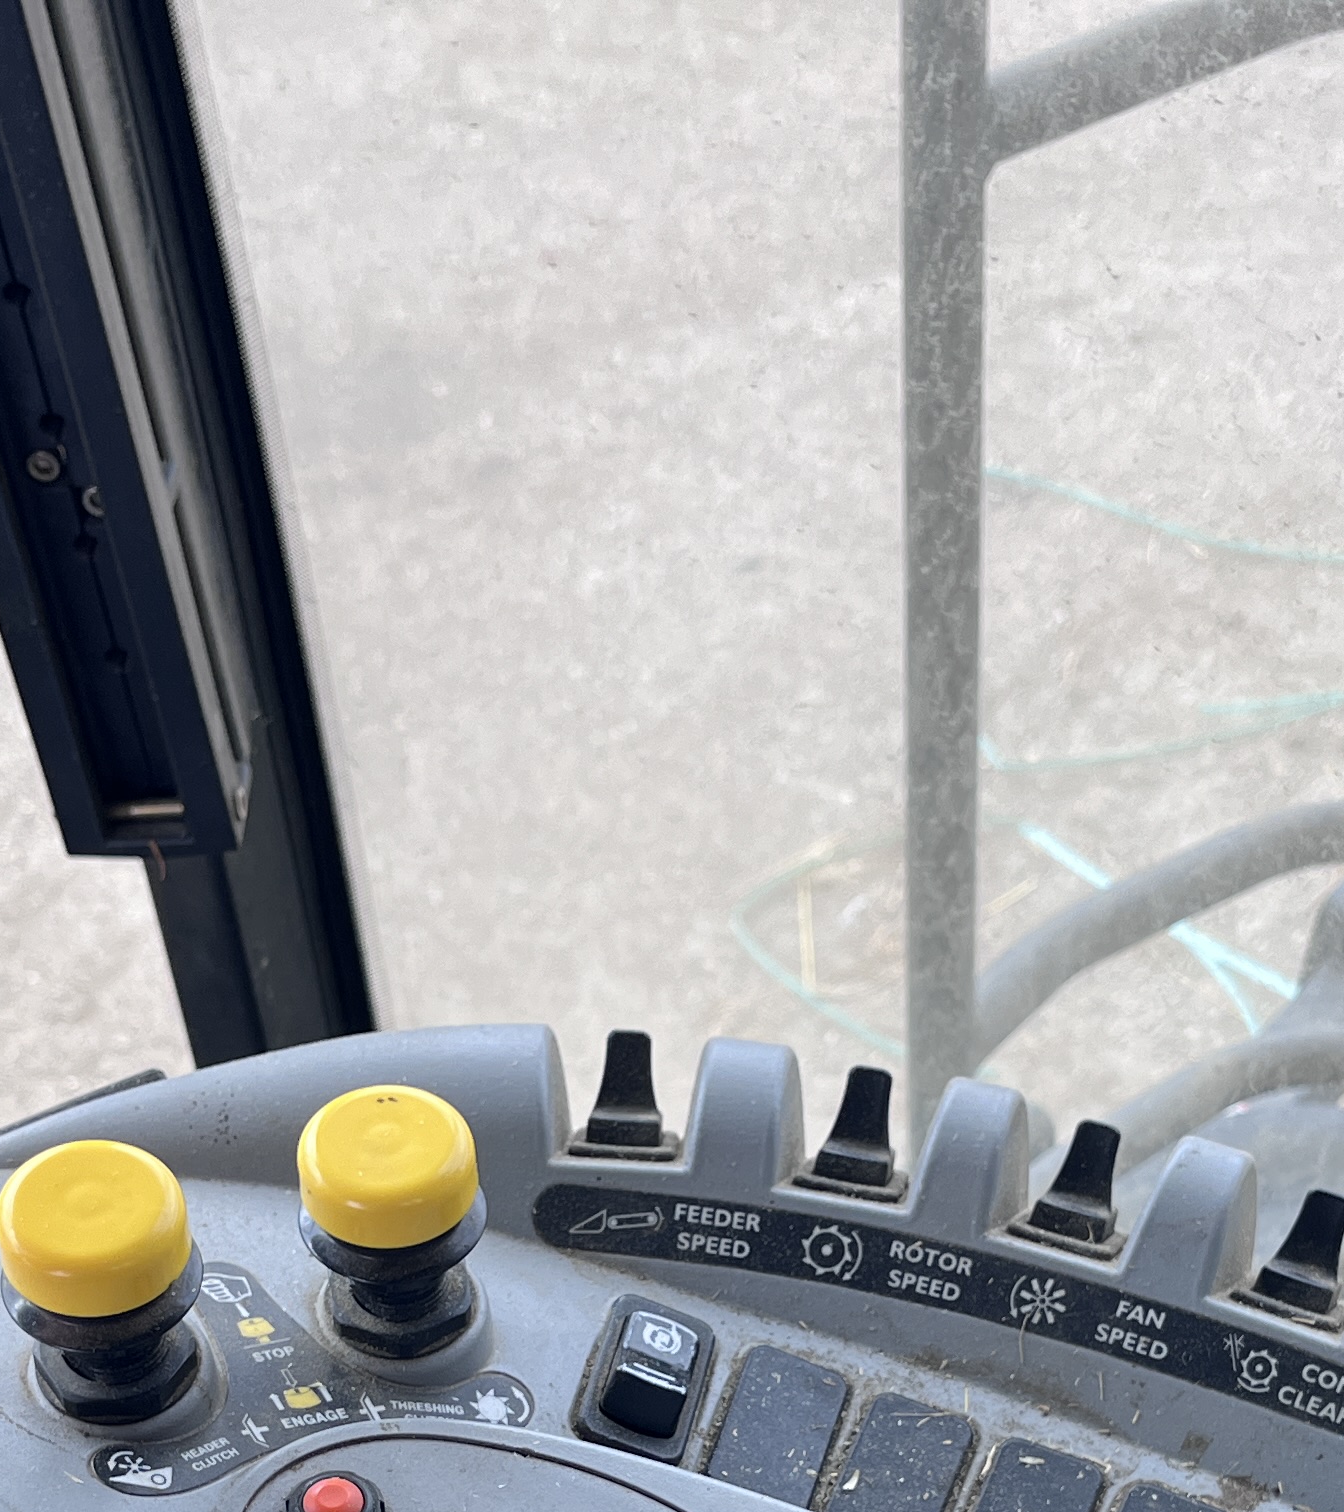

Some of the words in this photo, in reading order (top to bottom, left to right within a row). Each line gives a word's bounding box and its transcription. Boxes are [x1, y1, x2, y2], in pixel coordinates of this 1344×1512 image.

[673, 1202, 761, 1233] FEEDER
[676, 1231, 751, 1259] SPEED
[888, 1239, 973, 1277] ROTOR
[886, 1269, 961, 1302] SPEED
[1115, 1300, 1167, 1331] FAN
[252, 1345, 295, 1363] STOP
[1094, 1323, 1169, 1361] SPEED
[280, 1407, 350, 1429] ENGAGE
[389, 1400, 465, 1416] THRESHING
[180, 1436, 231, 1462] HEADER
[191, 1446, 240, 1472] CLUTCH
